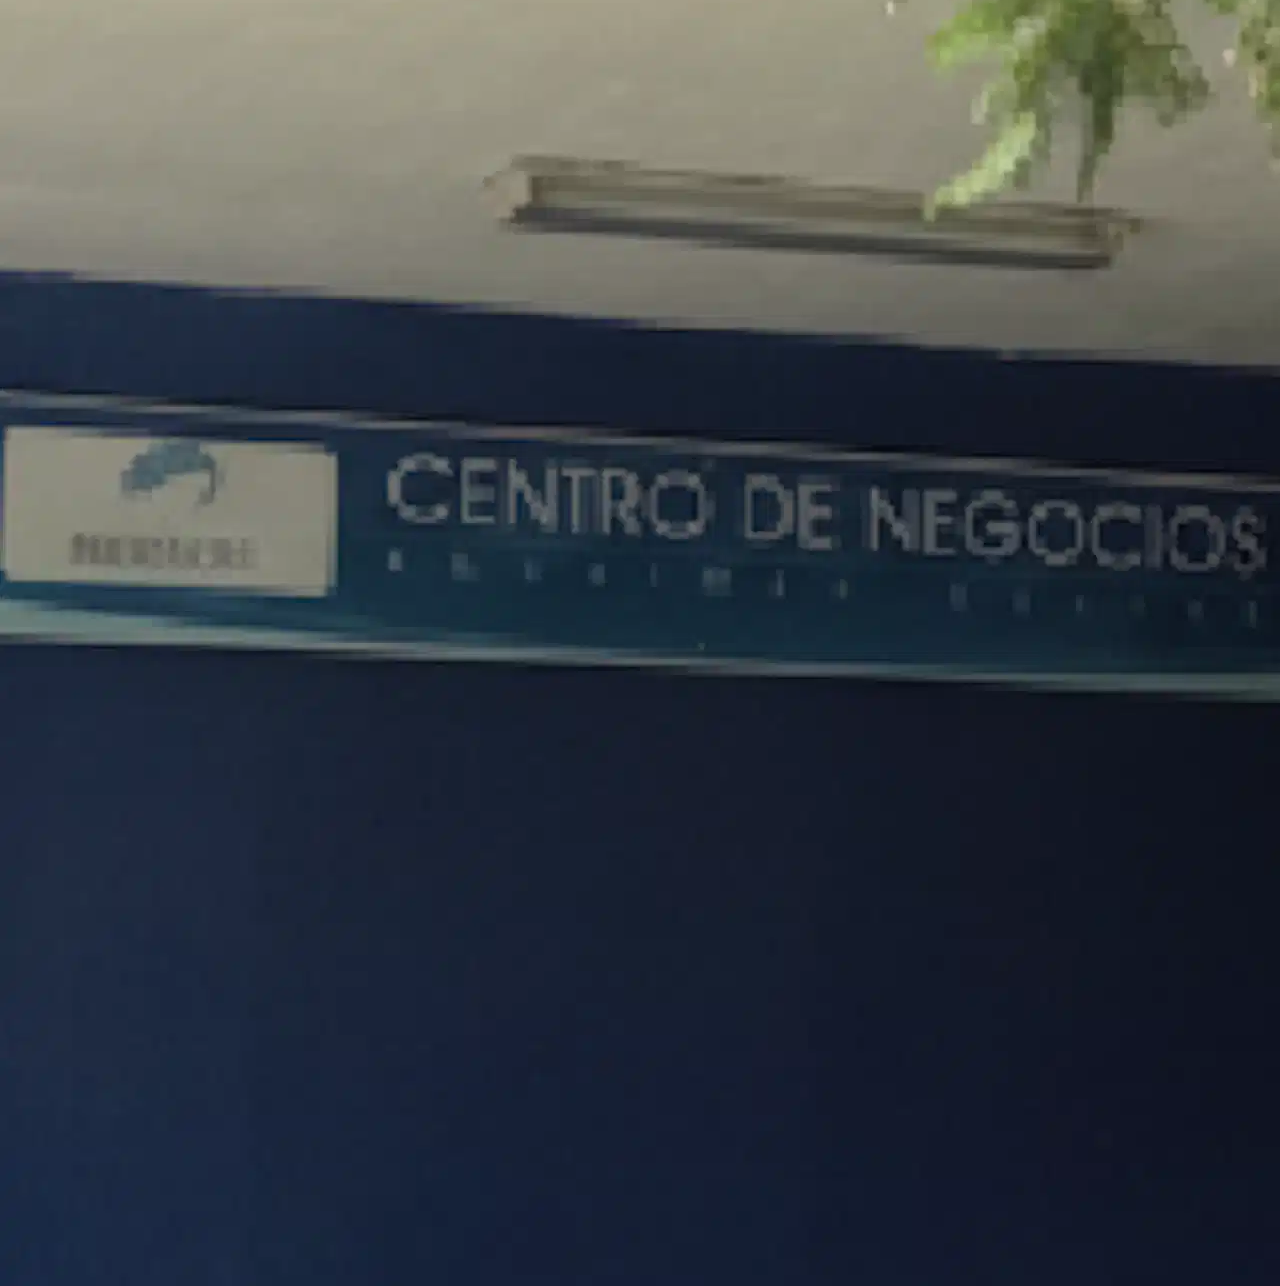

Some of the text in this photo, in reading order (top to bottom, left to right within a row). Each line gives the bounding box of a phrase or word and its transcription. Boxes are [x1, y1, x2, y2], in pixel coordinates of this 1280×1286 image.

[387, 452, 1268, 577] CENTRO DE NEGOCIOS
